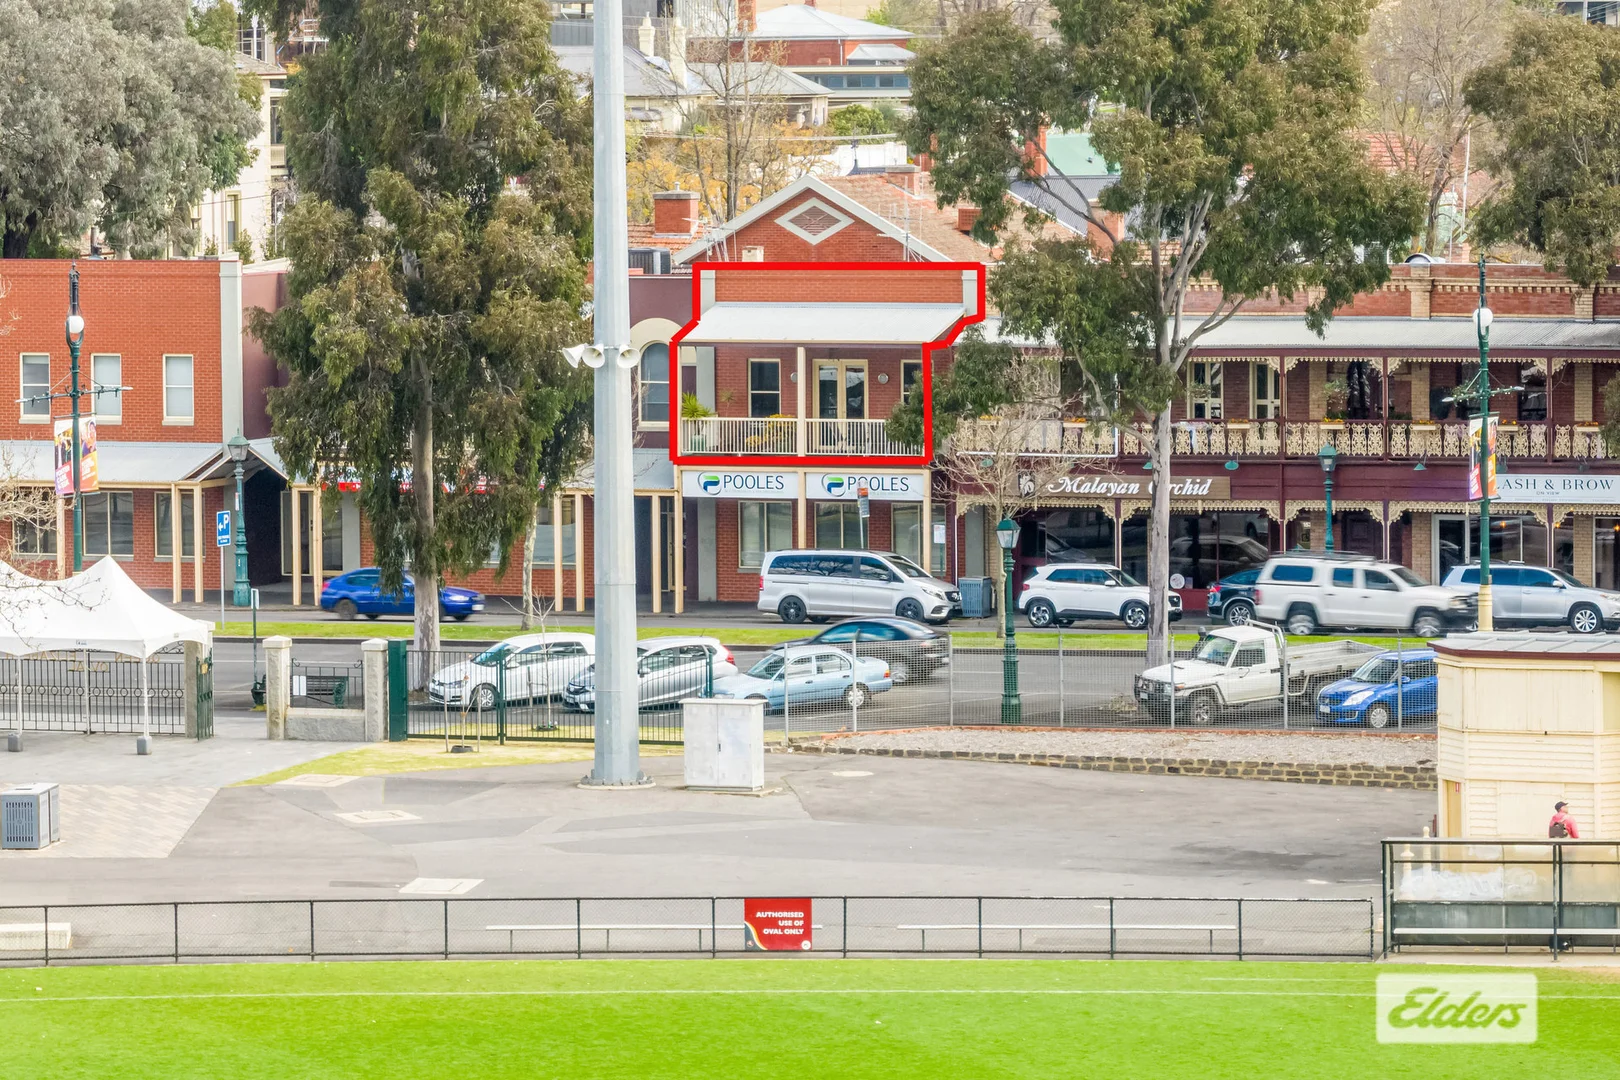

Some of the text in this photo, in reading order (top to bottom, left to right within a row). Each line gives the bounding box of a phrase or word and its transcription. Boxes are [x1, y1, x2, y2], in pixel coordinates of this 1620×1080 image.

[723, 474, 784, 490] POOLES
[1047, 475, 1213, 496] Malayan rchid
[1496, 478, 1614, 490] ASH & BROW
[223, 514, 229, 529] P
